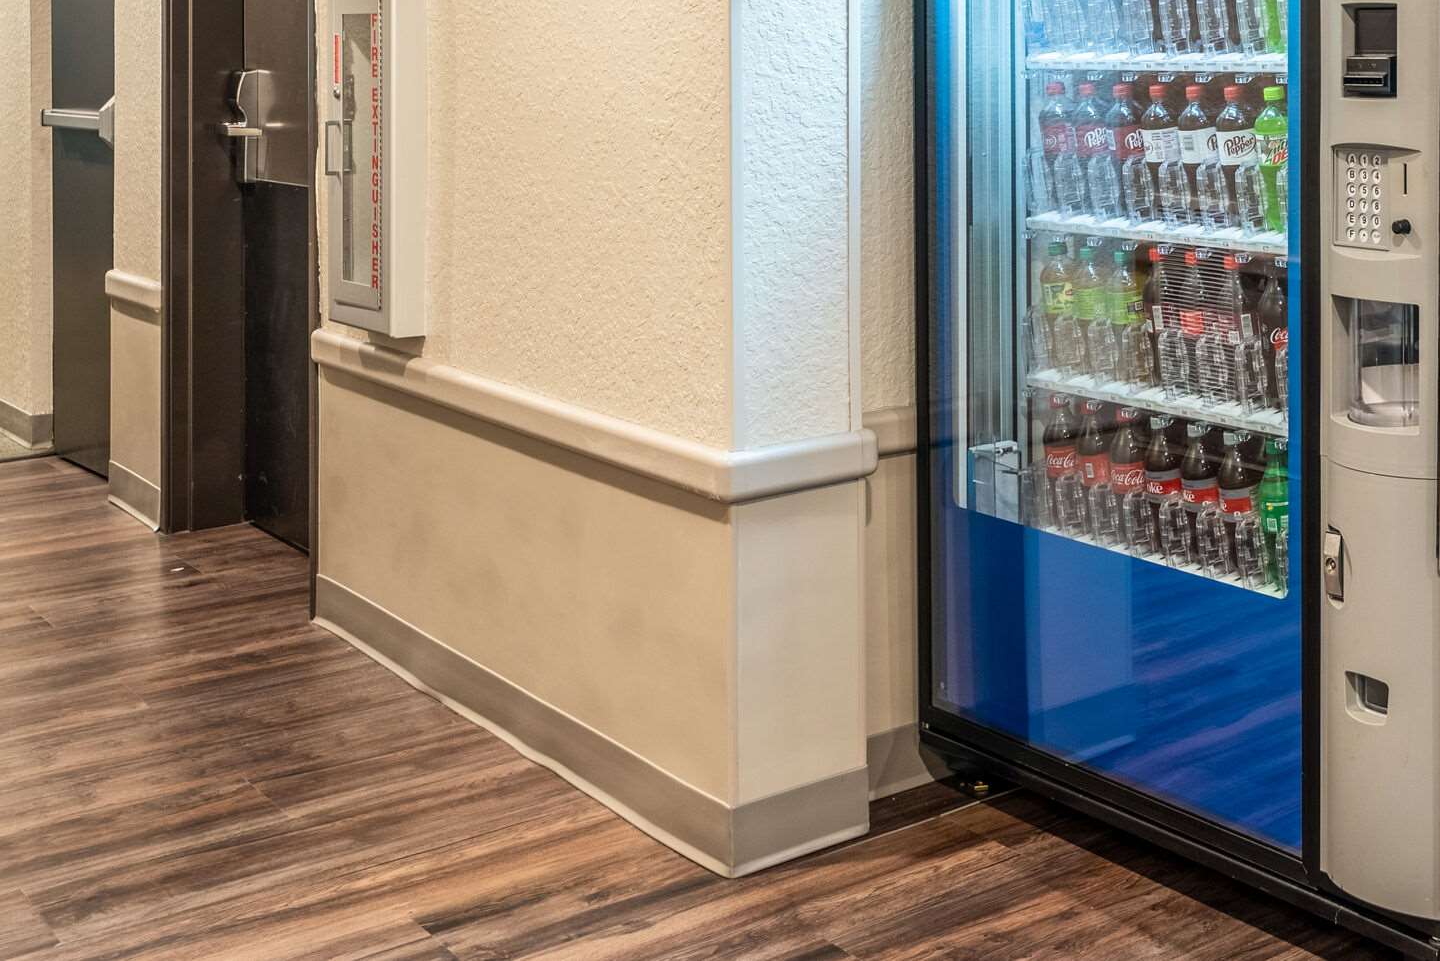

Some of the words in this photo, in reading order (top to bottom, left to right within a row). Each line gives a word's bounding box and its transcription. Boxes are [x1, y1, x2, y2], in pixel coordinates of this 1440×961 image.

[370, 13, 379, 78] FIRE
[1225, 137, 1254, 157] Pepper
[371, 89, 379, 288] EXTINGUISHER
